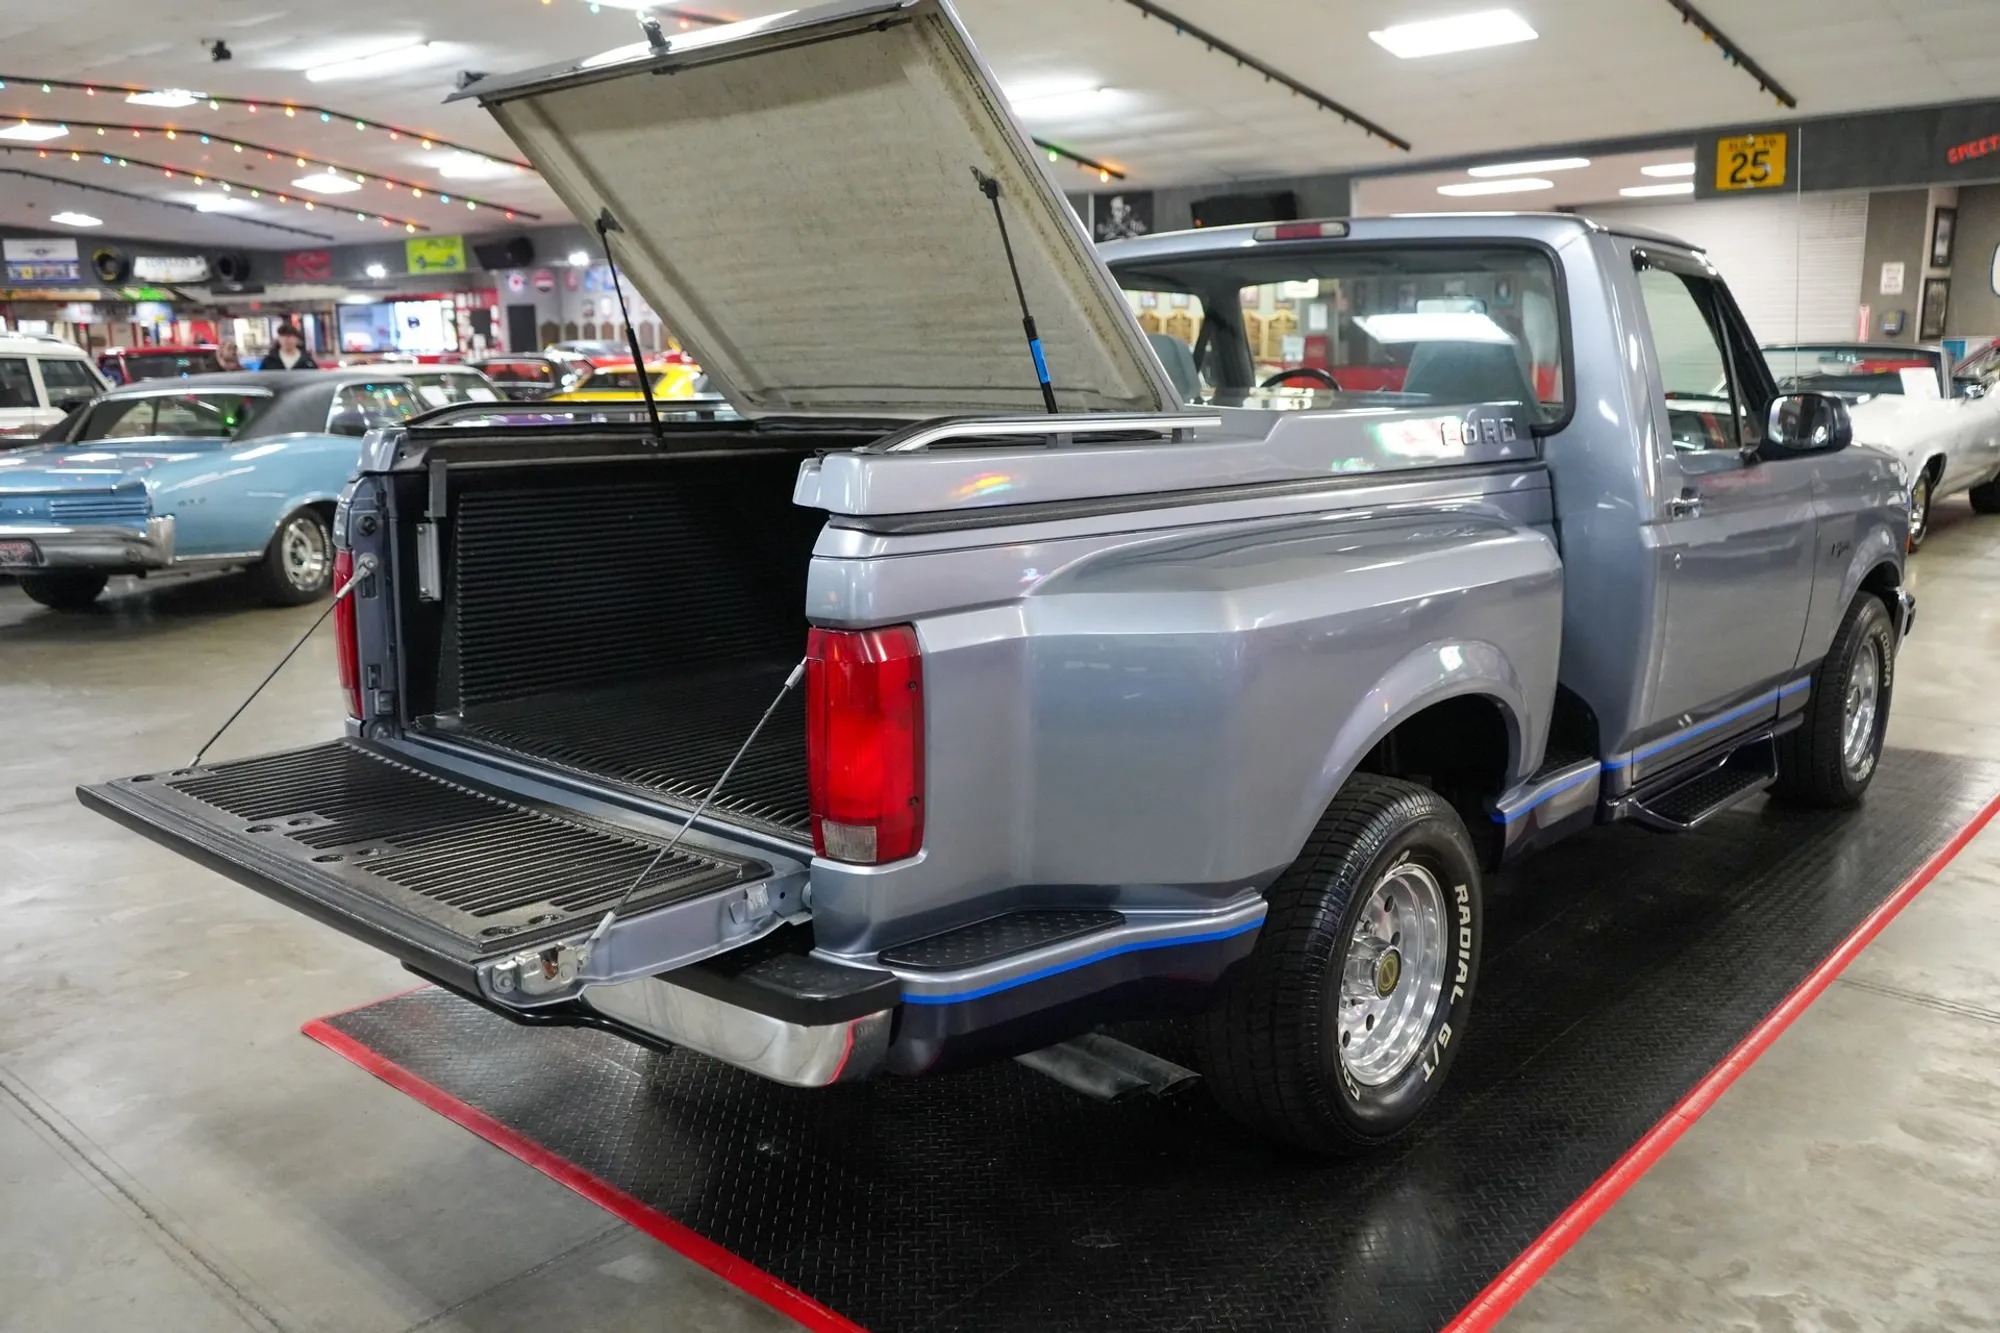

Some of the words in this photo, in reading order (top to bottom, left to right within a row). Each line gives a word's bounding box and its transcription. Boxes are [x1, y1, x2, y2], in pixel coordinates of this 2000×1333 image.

[1730, 149, 1771, 184] 25
[1450, 884, 1473, 1004] RADIAL
[1423, 1022, 1452, 1082] G/T
